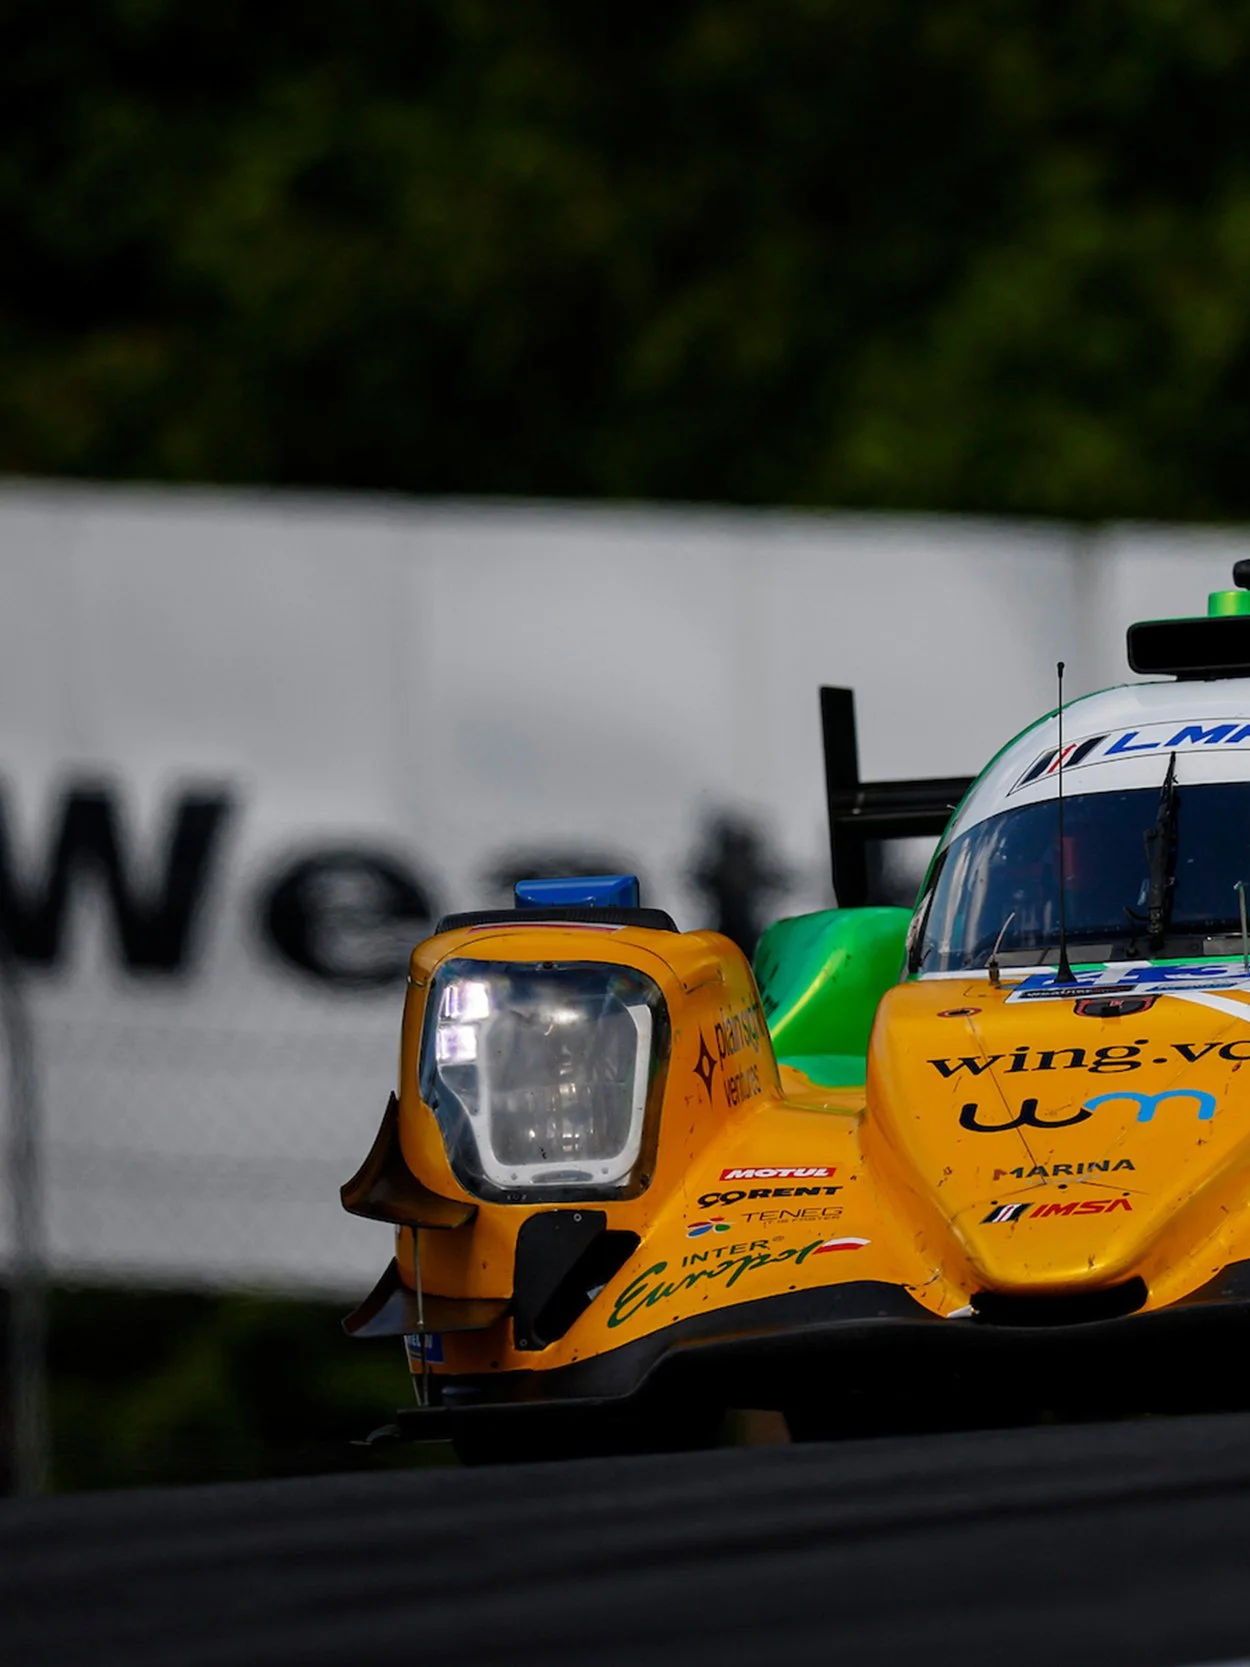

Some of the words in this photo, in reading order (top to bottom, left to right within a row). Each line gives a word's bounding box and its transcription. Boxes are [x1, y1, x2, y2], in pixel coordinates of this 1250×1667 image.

[724, 1167, 830, 1180] MOTUL
[993, 1159, 1136, 1181] MARINA
[741, 1206, 844, 1223] TENEG
[1029, 1199, 1133, 1219] IMSA
[682, 1239, 770, 1268] INTER
[607, 1240, 825, 1329] Europol
